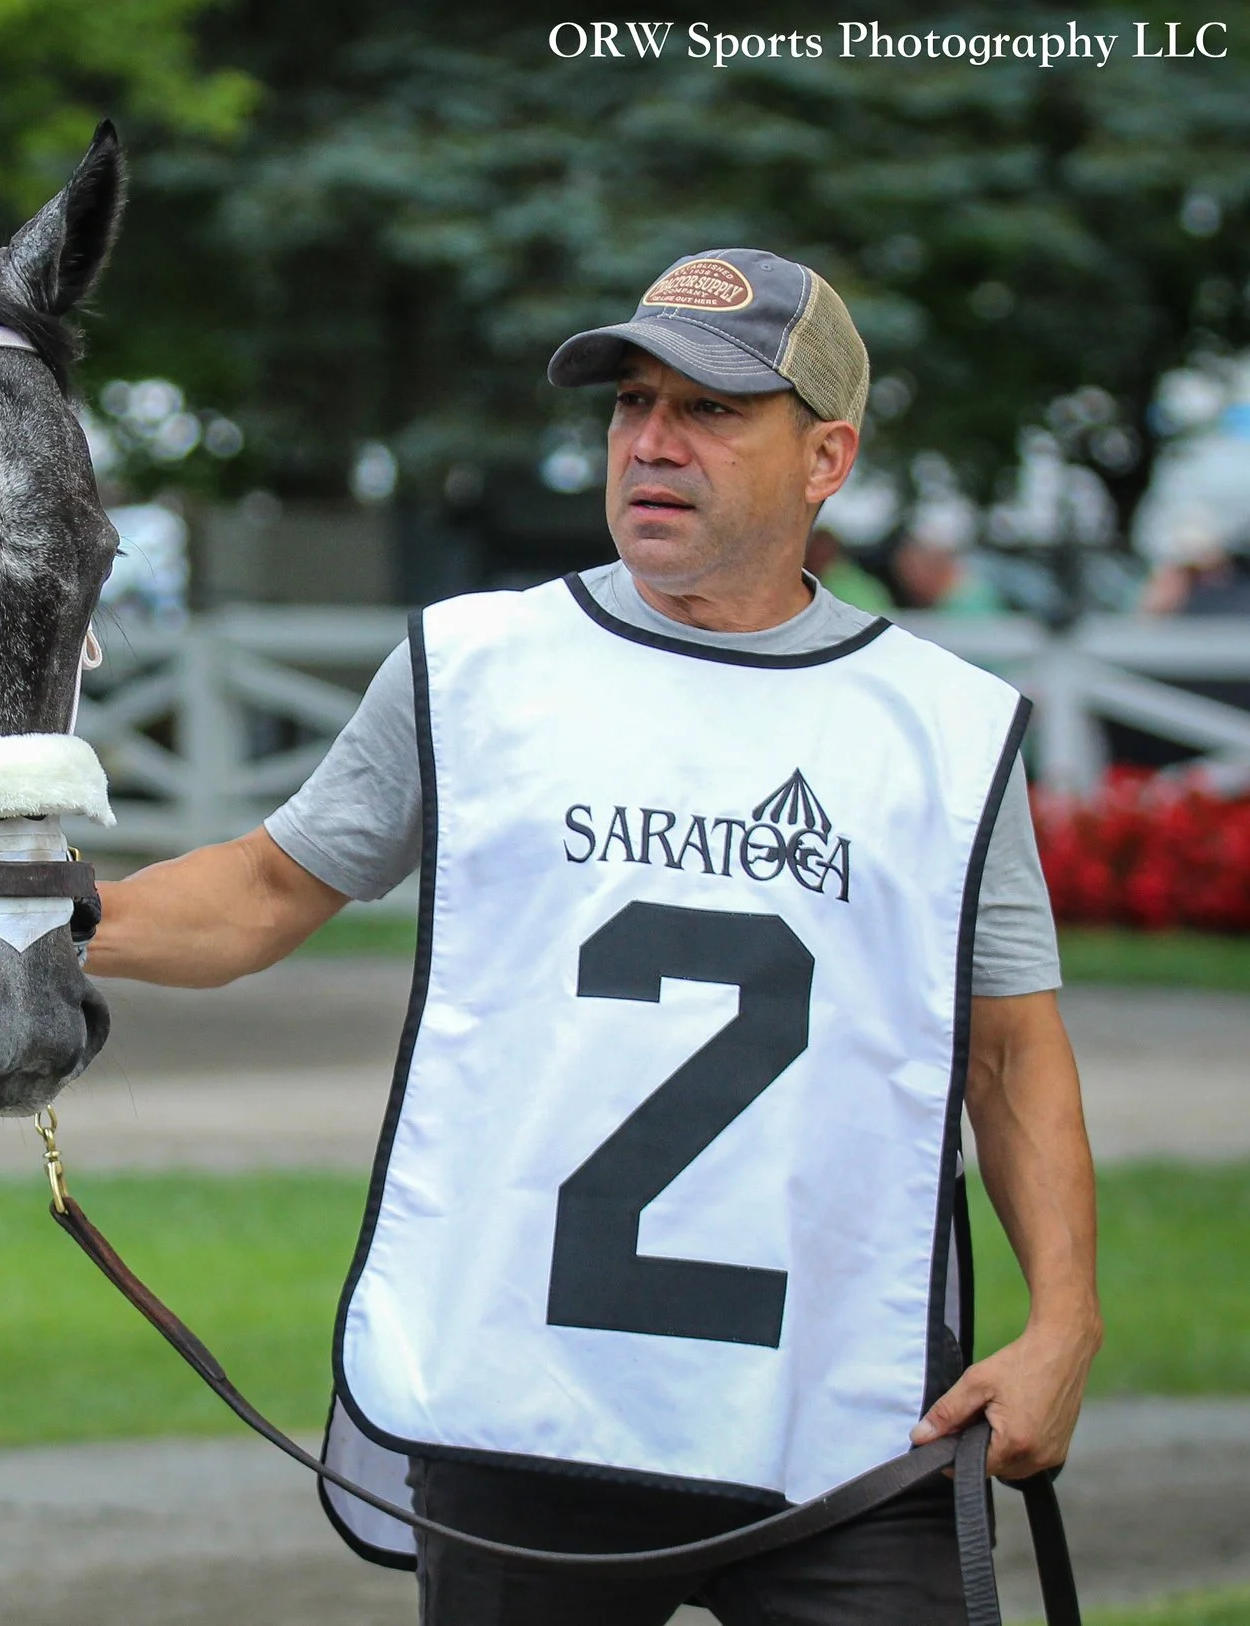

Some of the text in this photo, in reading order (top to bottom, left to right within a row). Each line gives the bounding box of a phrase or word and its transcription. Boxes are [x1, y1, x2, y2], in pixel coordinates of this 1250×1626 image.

[694, 276, 744, 303] SUPPLY
[563, 803, 851, 903] SARATOGA
[547, 900, 815, 1349] 2
